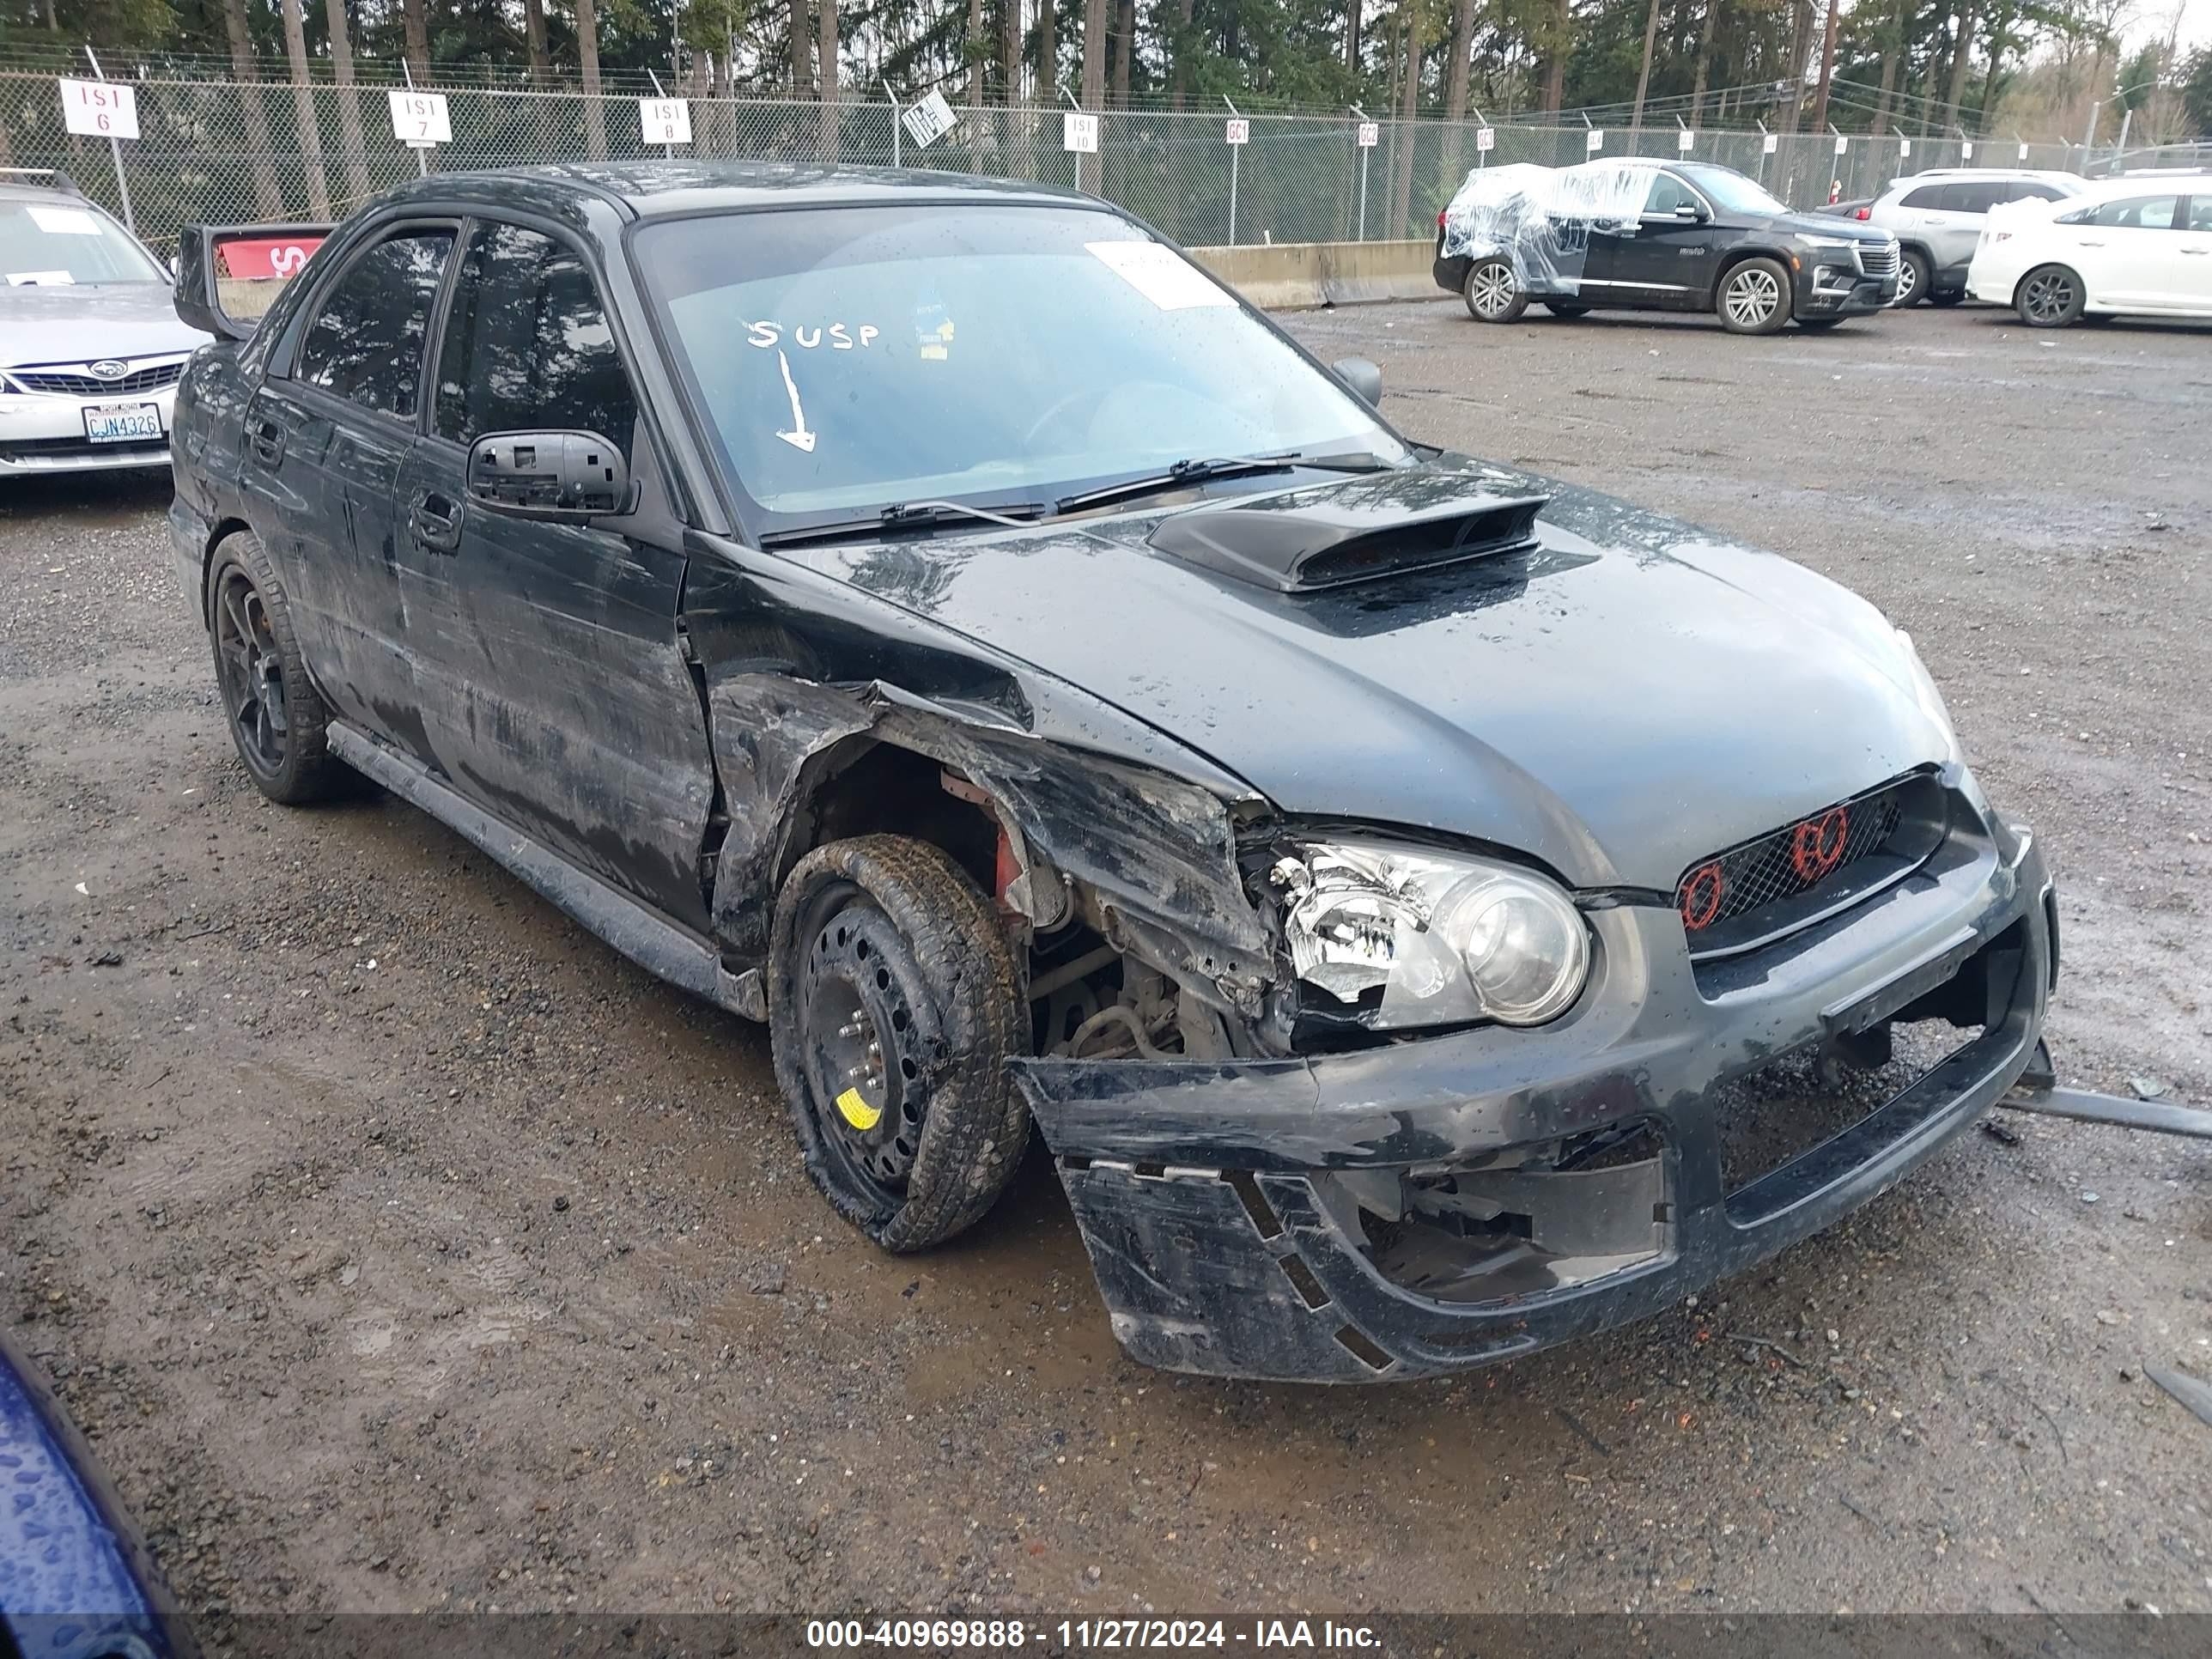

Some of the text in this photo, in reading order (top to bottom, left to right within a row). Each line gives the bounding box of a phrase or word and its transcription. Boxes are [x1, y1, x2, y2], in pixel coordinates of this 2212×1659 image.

[97, 113, 110, 131] 6
[418, 121, 428, 137] 7
[665, 125, 674, 138] 8
[1229, 123, 1247, 139] GC1
[1361, 126, 1377, 143] GC2
[747, 320, 879, 349] SUSP
[89, 415, 156, 436] CJN4326
